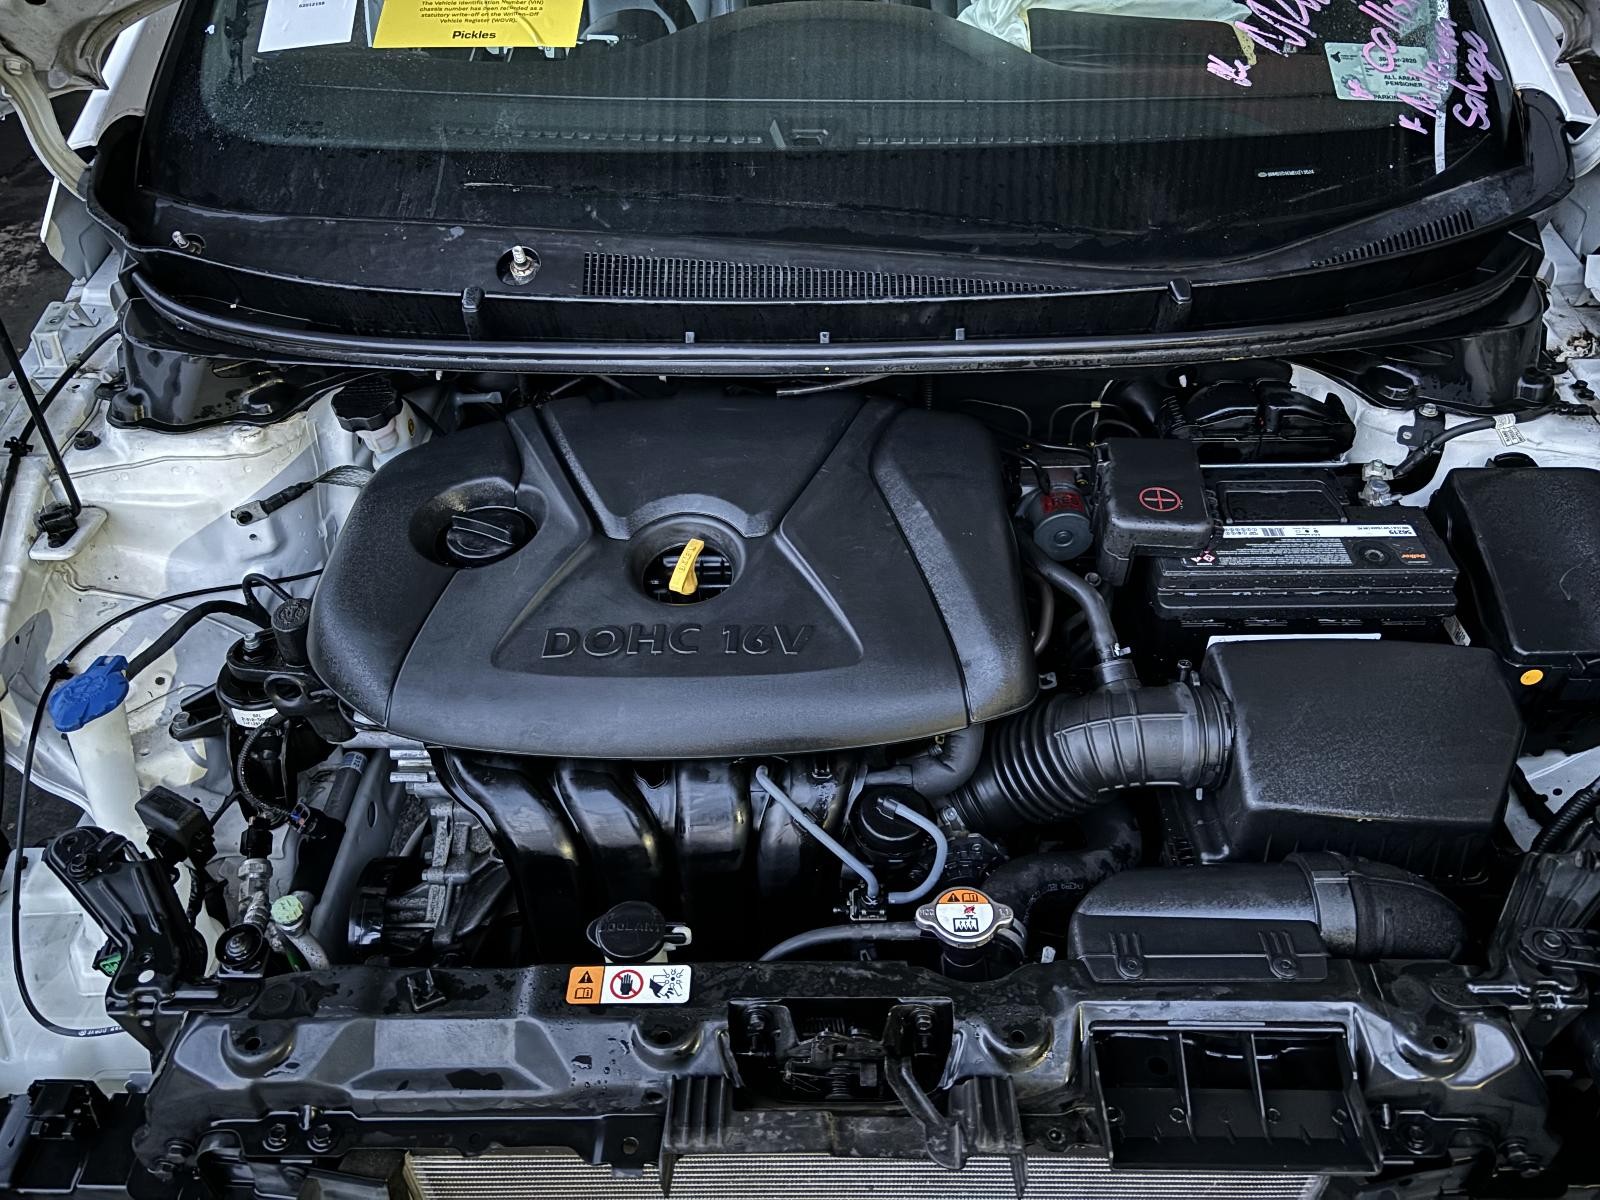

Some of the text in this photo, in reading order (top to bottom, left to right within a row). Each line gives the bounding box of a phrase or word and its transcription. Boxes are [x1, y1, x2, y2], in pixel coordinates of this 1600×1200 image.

[452, 30, 497, 39] Pickles
[541, 623, 814, 659] DOHC 16V
